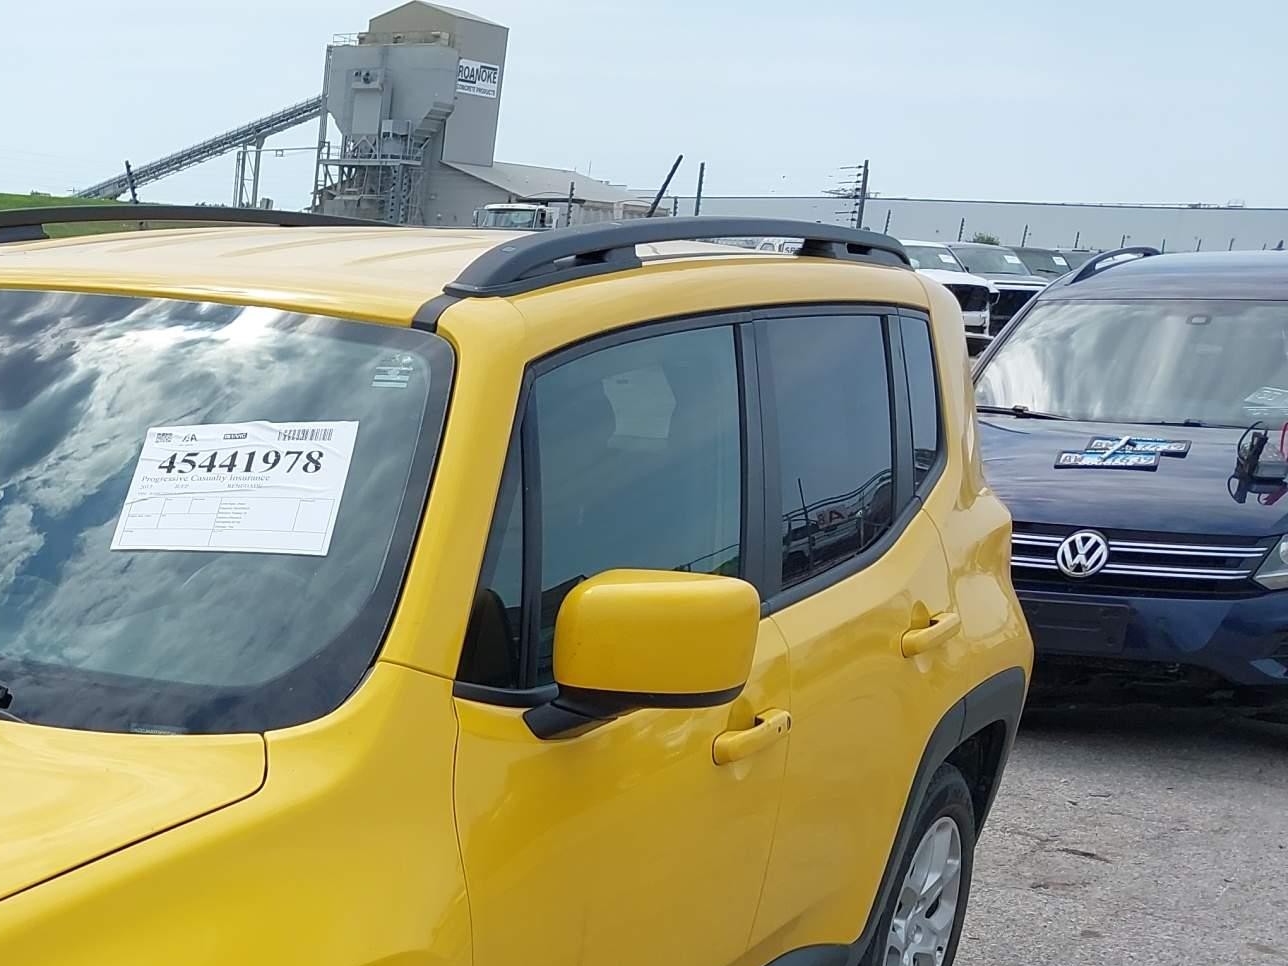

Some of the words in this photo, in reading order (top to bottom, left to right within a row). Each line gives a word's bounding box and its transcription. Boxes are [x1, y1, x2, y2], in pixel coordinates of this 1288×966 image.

[457, 65, 497, 84] ROANOKE
[158, 450, 324, 474] 45441978
[141, 474, 189, 483] Progressive
[190, 473, 227, 483] Casualty
[229, 474, 271, 482] Insurance
